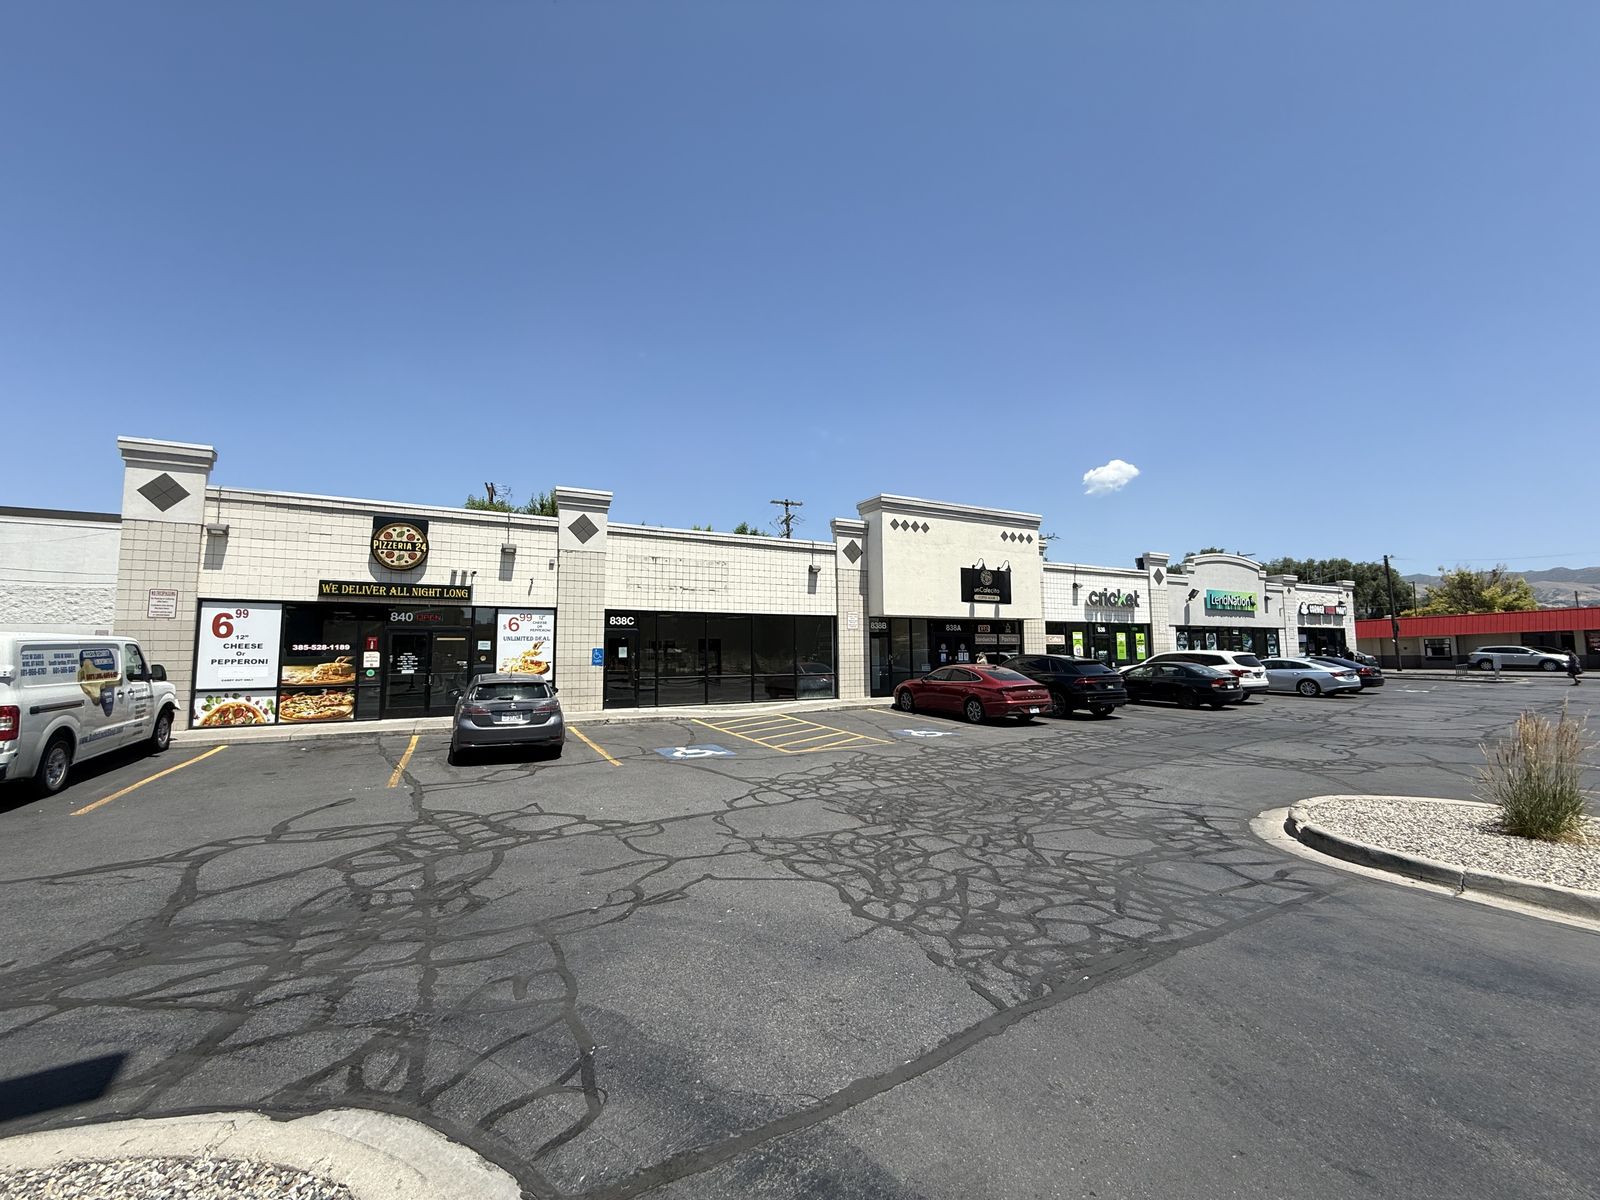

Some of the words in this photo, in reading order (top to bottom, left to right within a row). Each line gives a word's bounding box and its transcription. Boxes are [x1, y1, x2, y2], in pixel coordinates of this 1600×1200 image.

[373, 539, 412, 551] PIZZERIA
[415, 542, 427, 553] 24
[322, 582, 339, 594] WE
[341, 584, 387, 596] DELIVER
[389, 586, 410, 597] ALL
[411, 587, 442, 598] NIGHT
[443, 588, 469, 598] LONG
[1088, 587, 1140, 608] cricket
[1209, 593, 1251, 607] LendNation
[211, 612, 235, 639] 6
[235, 608, 249, 618] 99
[390, 612, 414, 622] 840
[508, 616, 520, 632] 6
[519, 613, 533, 622] 99
[609, 616, 635, 626] 838C
[870, 621, 887, 630] 838B
[945, 624, 962, 632] 838A
[292, 643, 351, 651] 385-528-1189
